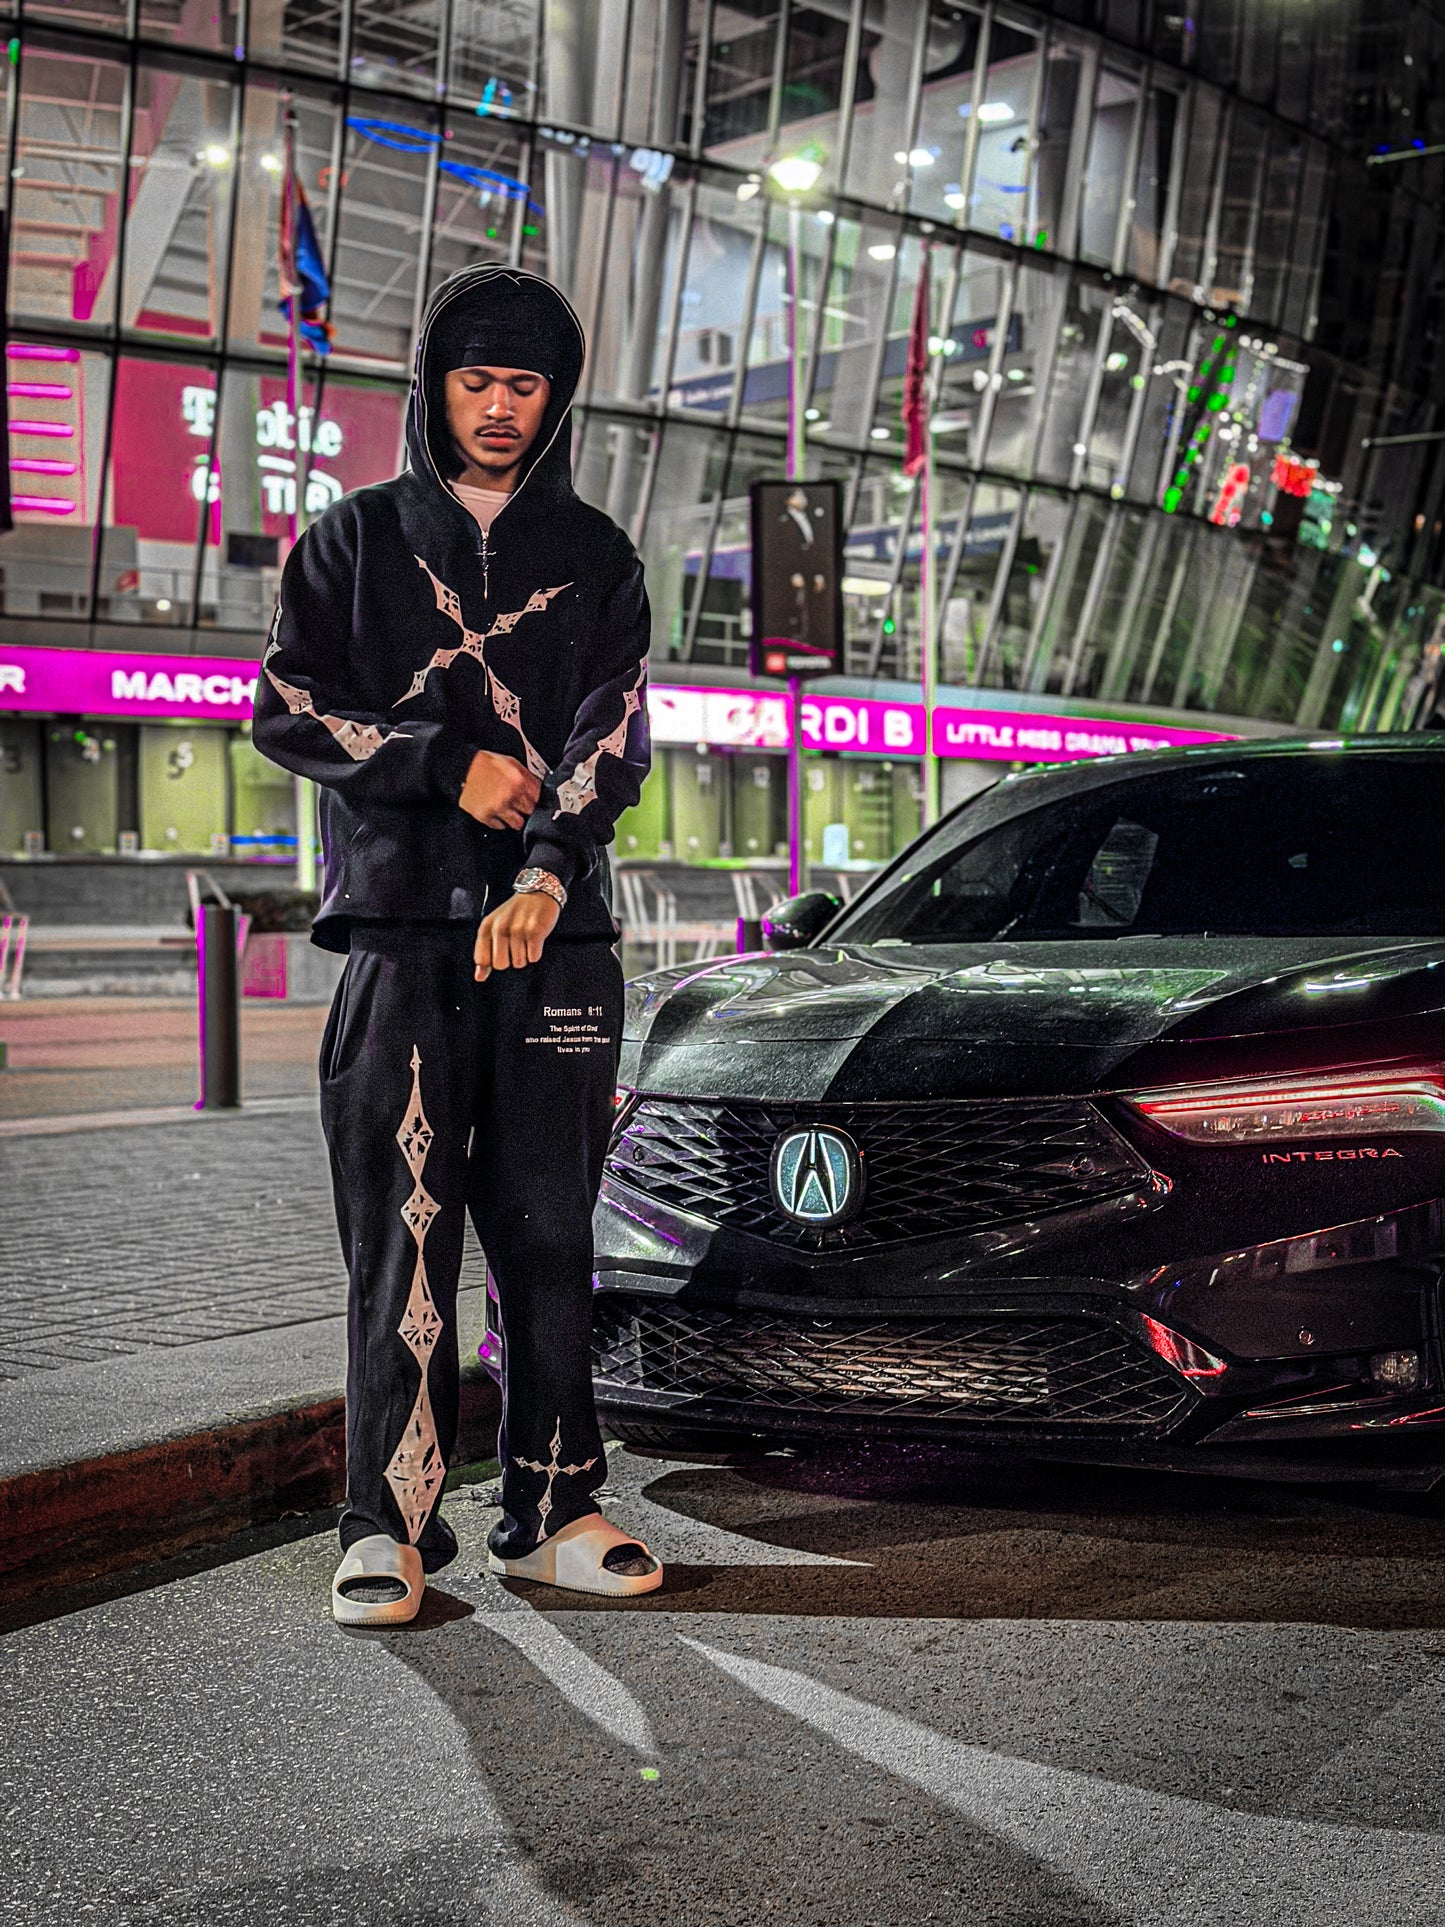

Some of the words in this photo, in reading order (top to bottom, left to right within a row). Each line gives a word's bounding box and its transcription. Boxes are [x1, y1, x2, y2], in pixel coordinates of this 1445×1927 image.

[111, 669, 258, 705] MARCH
[883, 709, 914, 747] B
[946, 722, 1014, 748] LITTLE
[543, 1006, 582, 1017] Romans
[1262, 1147, 1404, 1165] INTEGRA
